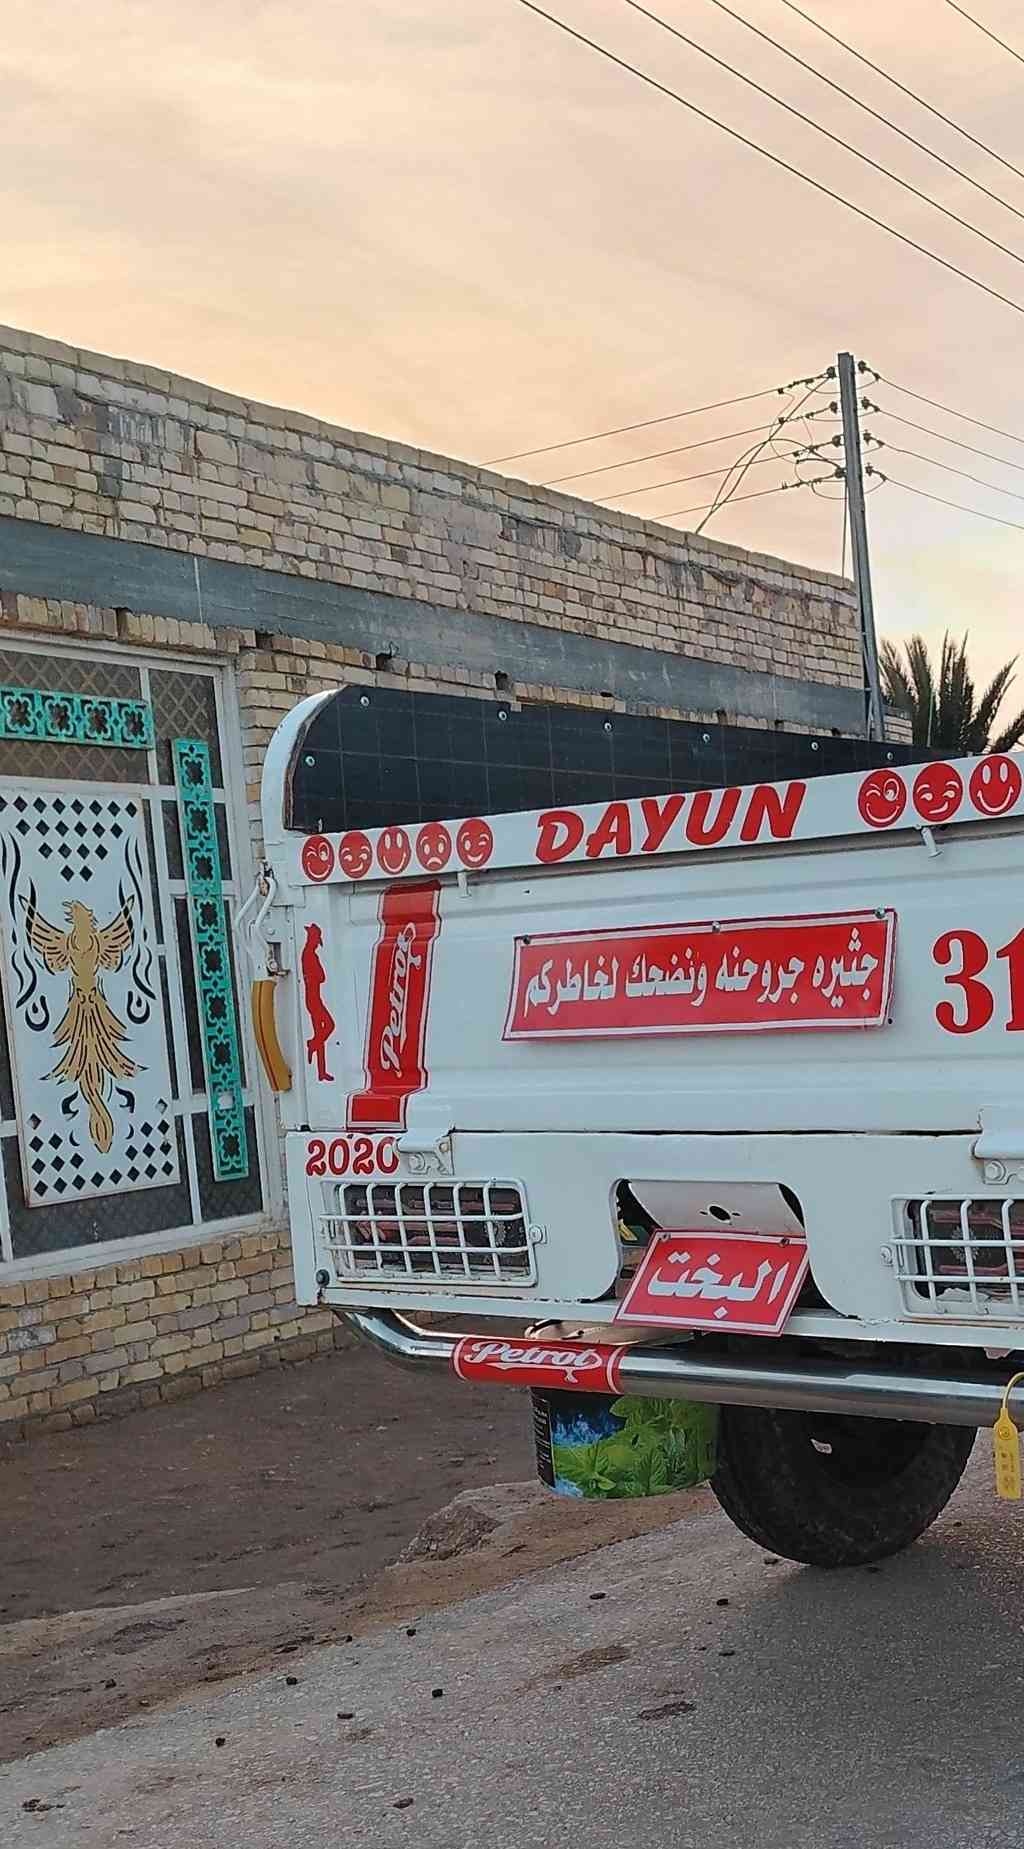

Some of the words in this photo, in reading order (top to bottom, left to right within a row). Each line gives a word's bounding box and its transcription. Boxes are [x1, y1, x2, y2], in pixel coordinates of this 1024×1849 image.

[535, 782, 807, 864] DAYUN
[523, 954, 620, 1018] لخاطركم
[305, 1137, 400, 1176] 2020
[647, 1251, 790, 1320] البخت
